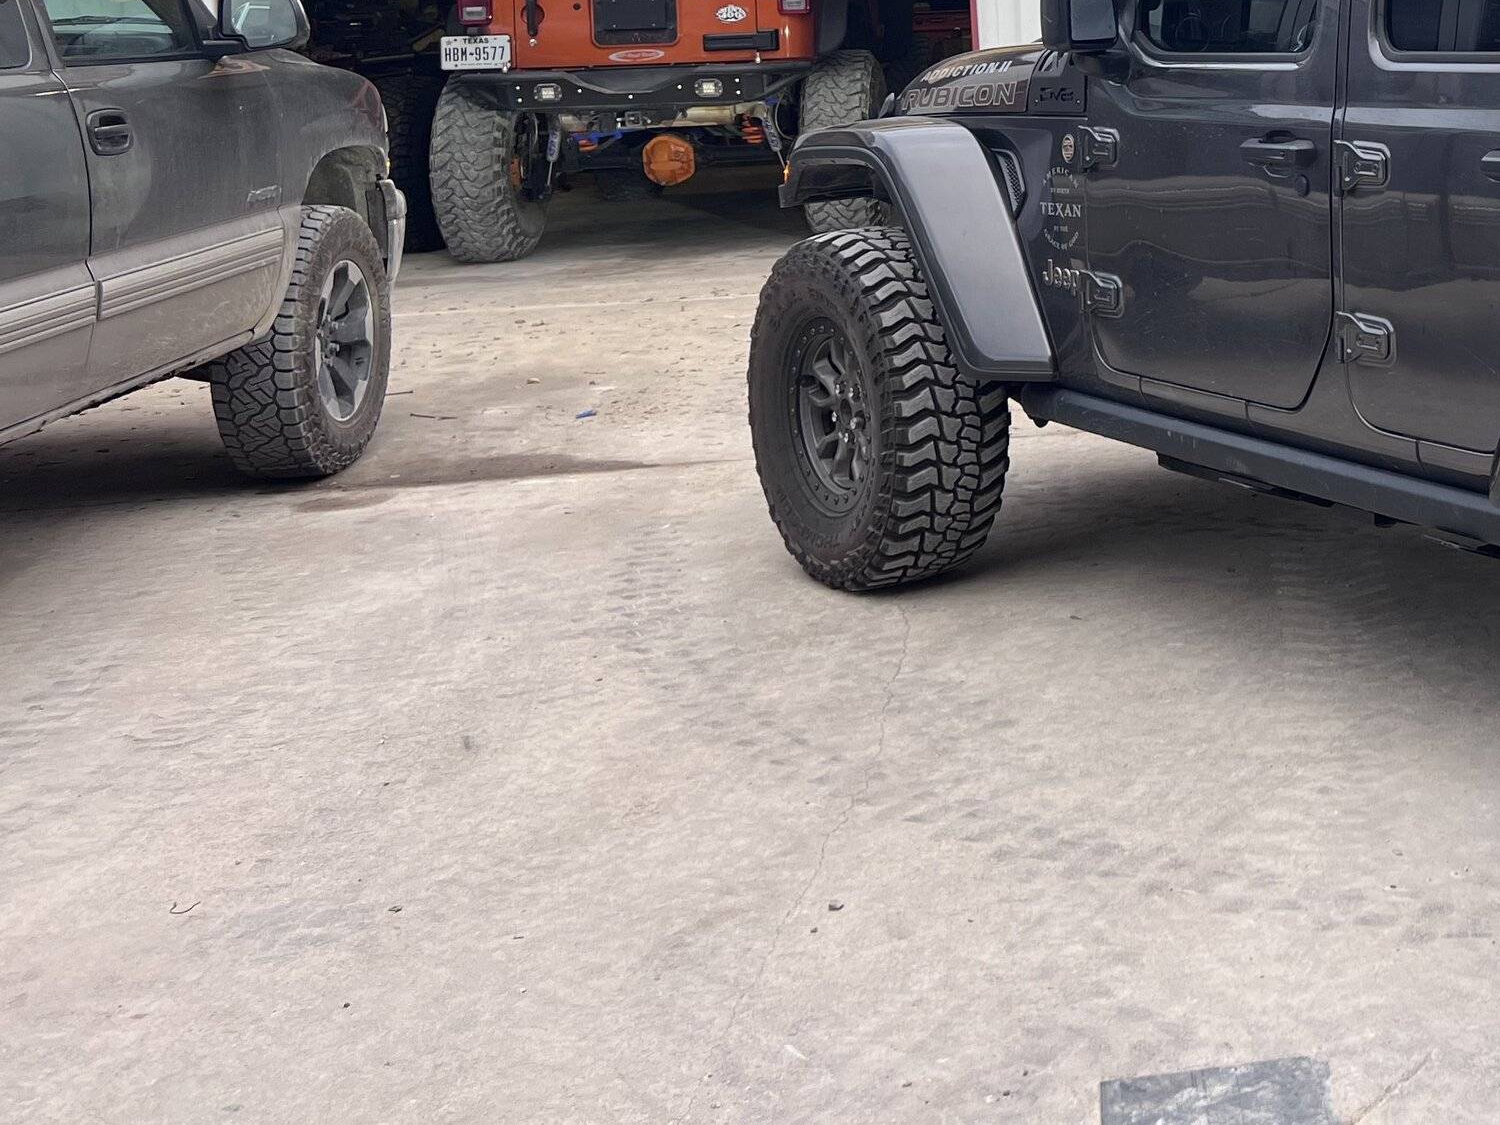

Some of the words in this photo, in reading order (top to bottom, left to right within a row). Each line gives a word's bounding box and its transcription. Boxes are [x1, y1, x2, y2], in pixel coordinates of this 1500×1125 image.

[920, 62, 997, 82] ADDICTION
[902, 82, 1018, 111] RUBICON
[1040, 202, 1081, 218] TEXAN
[1042, 258, 1080, 297] Jeep
